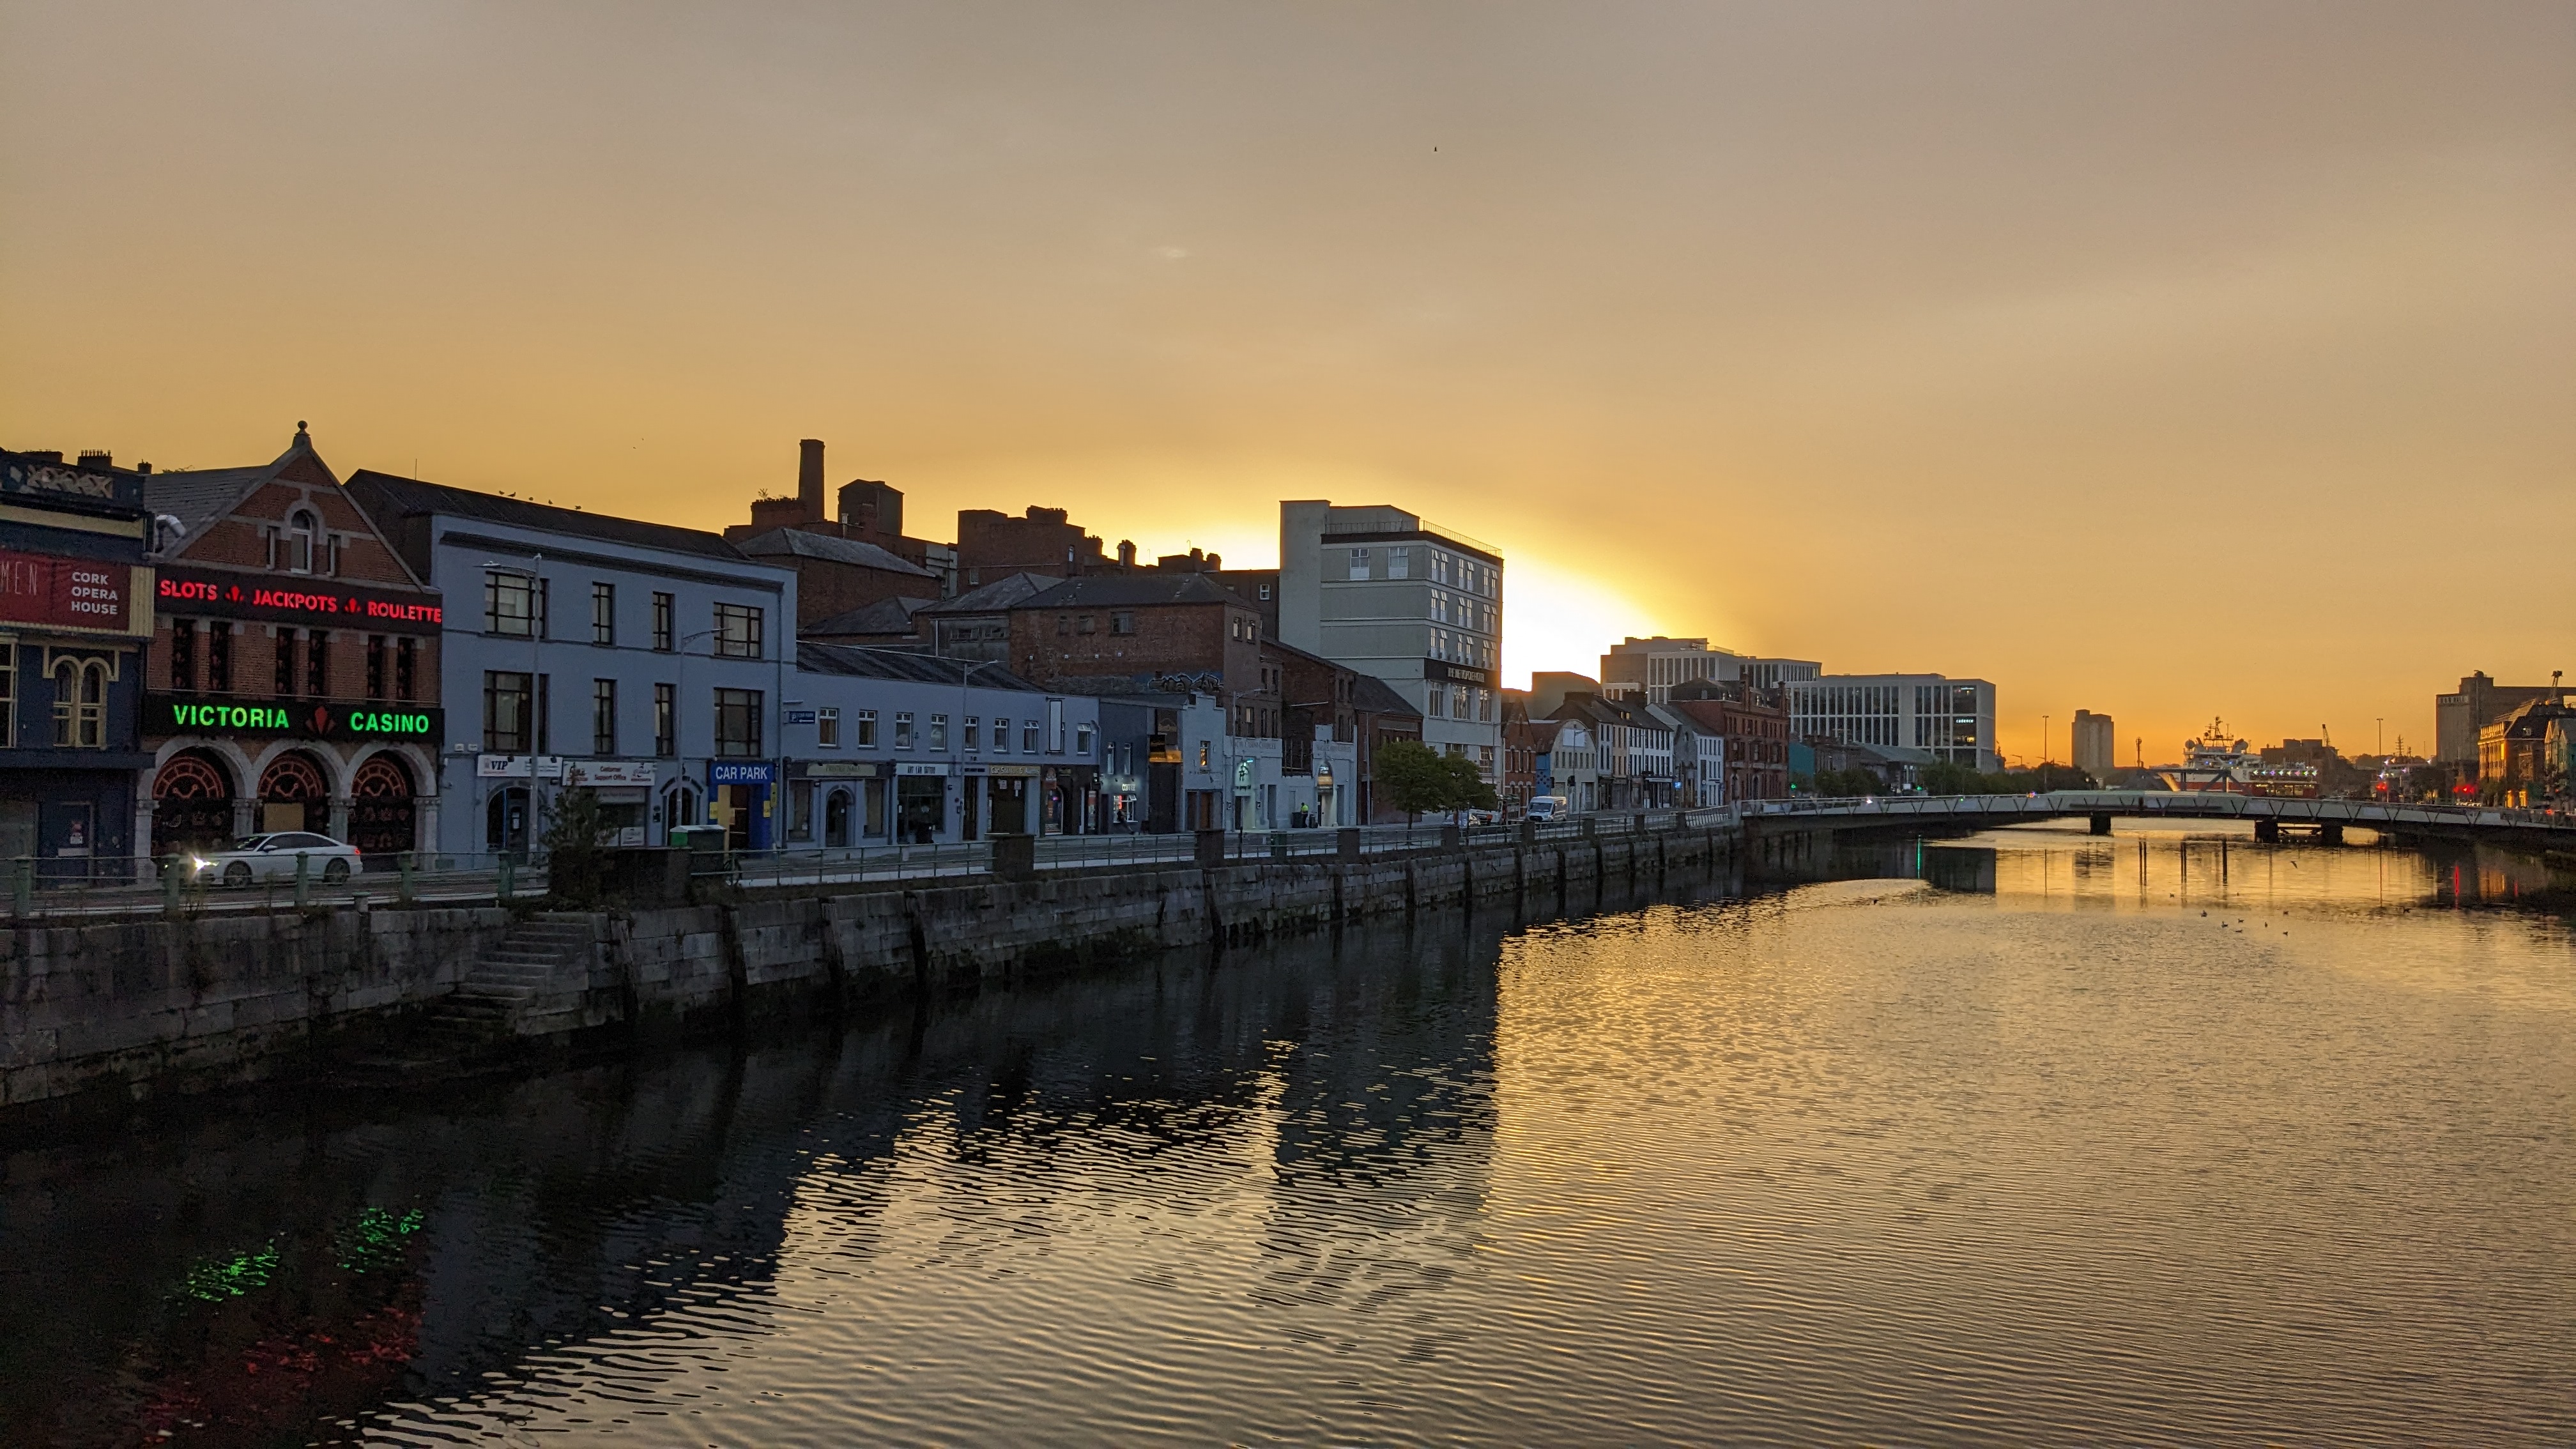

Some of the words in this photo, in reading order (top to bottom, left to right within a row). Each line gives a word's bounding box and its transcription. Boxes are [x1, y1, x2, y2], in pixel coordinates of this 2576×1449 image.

[72, 572, 109, 585] CORK
[71, 586, 118, 601] OPERA
[71, 601, 118, 615] HOUSE
[160, 579, 217, 601] SLOTS
[252, 589, 337, 613] JACKPOTS
[367, 601, 442, 624] ROULETTE
[173, 705, 289, 728] VICTORIA
[350, 712, 429, 733] CASINO
[491, 760, 509, 770] VIP
[716, 766, 737, 780] CAR
[740, 767, 768, 780] PARK
